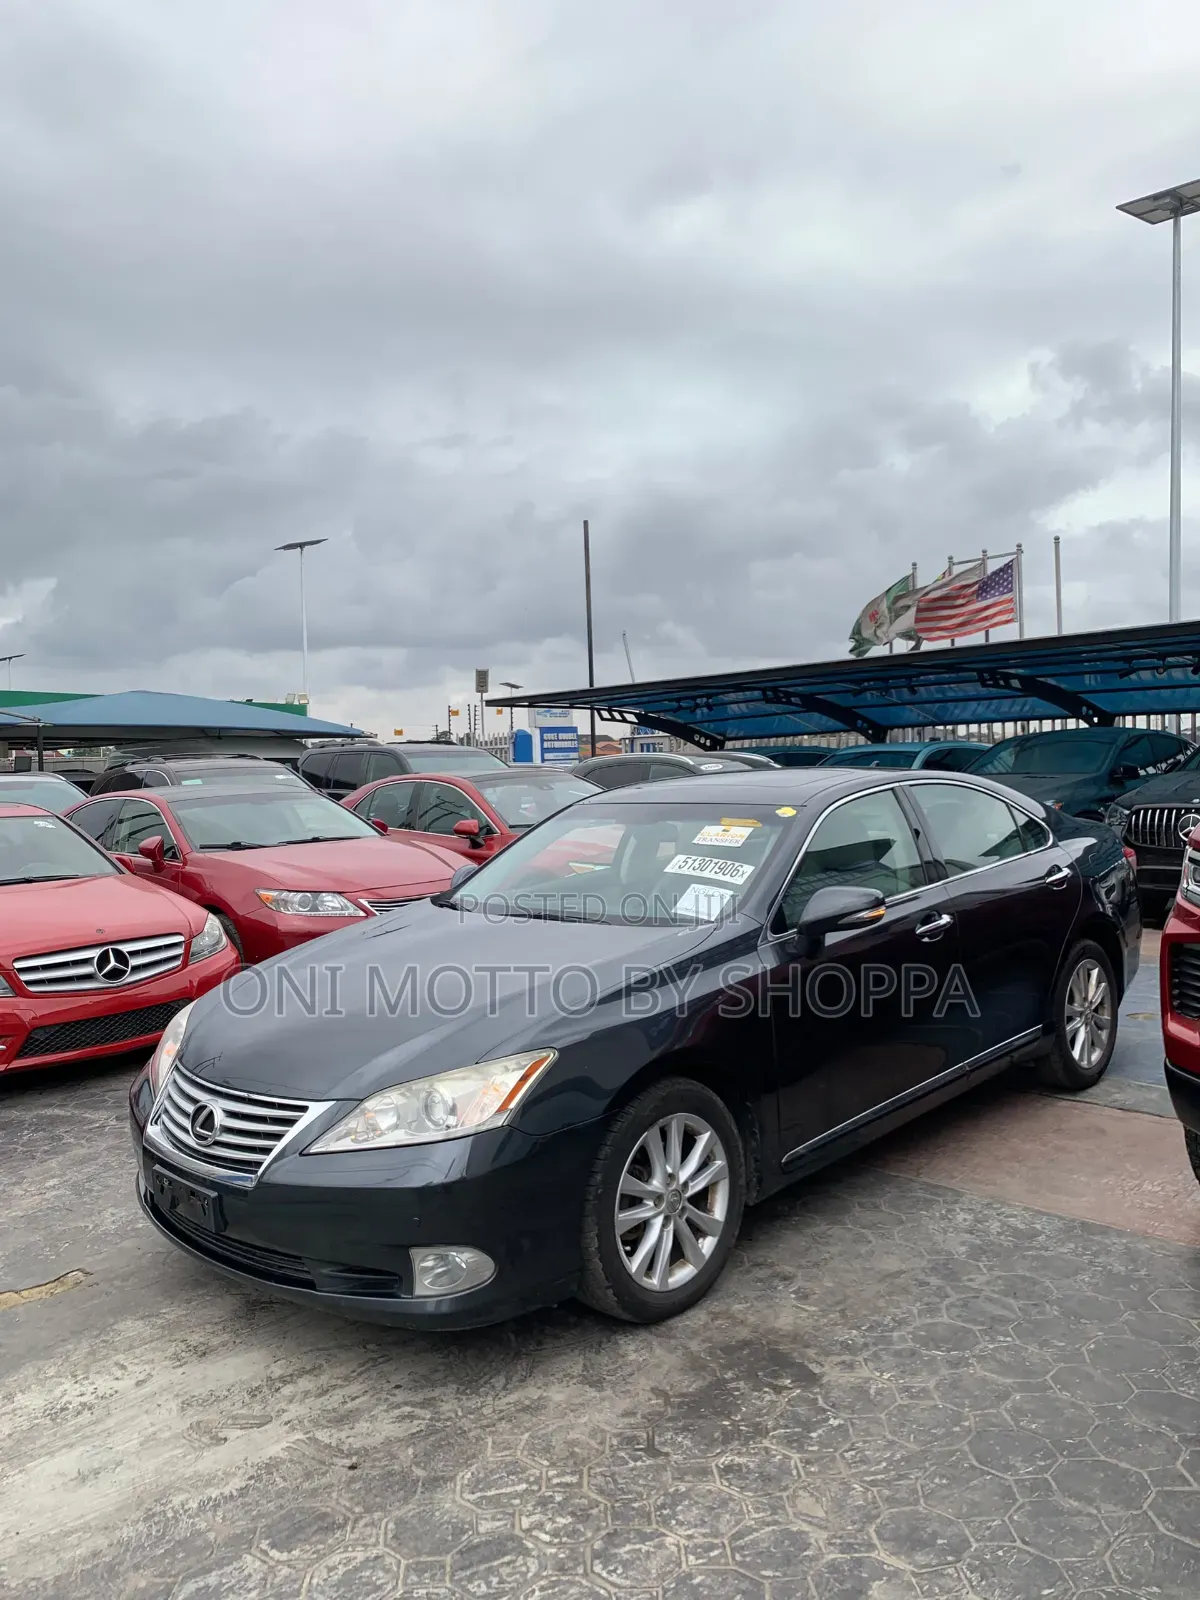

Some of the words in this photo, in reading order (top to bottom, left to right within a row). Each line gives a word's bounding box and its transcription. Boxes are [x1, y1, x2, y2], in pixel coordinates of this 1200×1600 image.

[700, 831, 745, 839] CLARION
[696, 837, 742, 845] TRANSFER
[678, 856, 743, 878] 51301906
